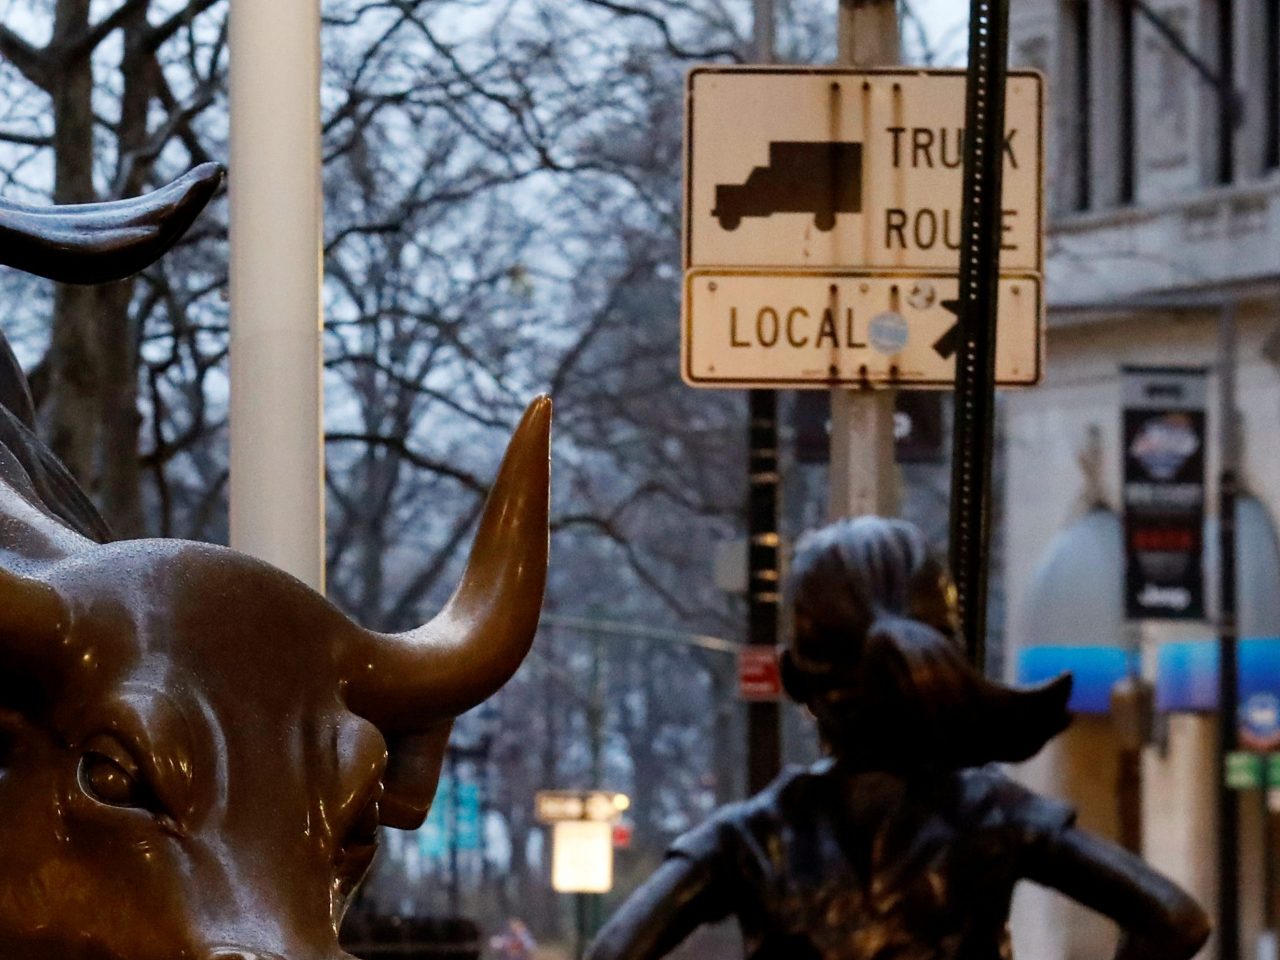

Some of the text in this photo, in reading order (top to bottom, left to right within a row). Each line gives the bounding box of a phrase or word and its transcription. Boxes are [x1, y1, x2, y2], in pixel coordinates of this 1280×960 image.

[886, 127, 1018, 169] TRUK
[885, 208, 1018, 250] ROUE
[729, 306, 867, 349] LOCAL
